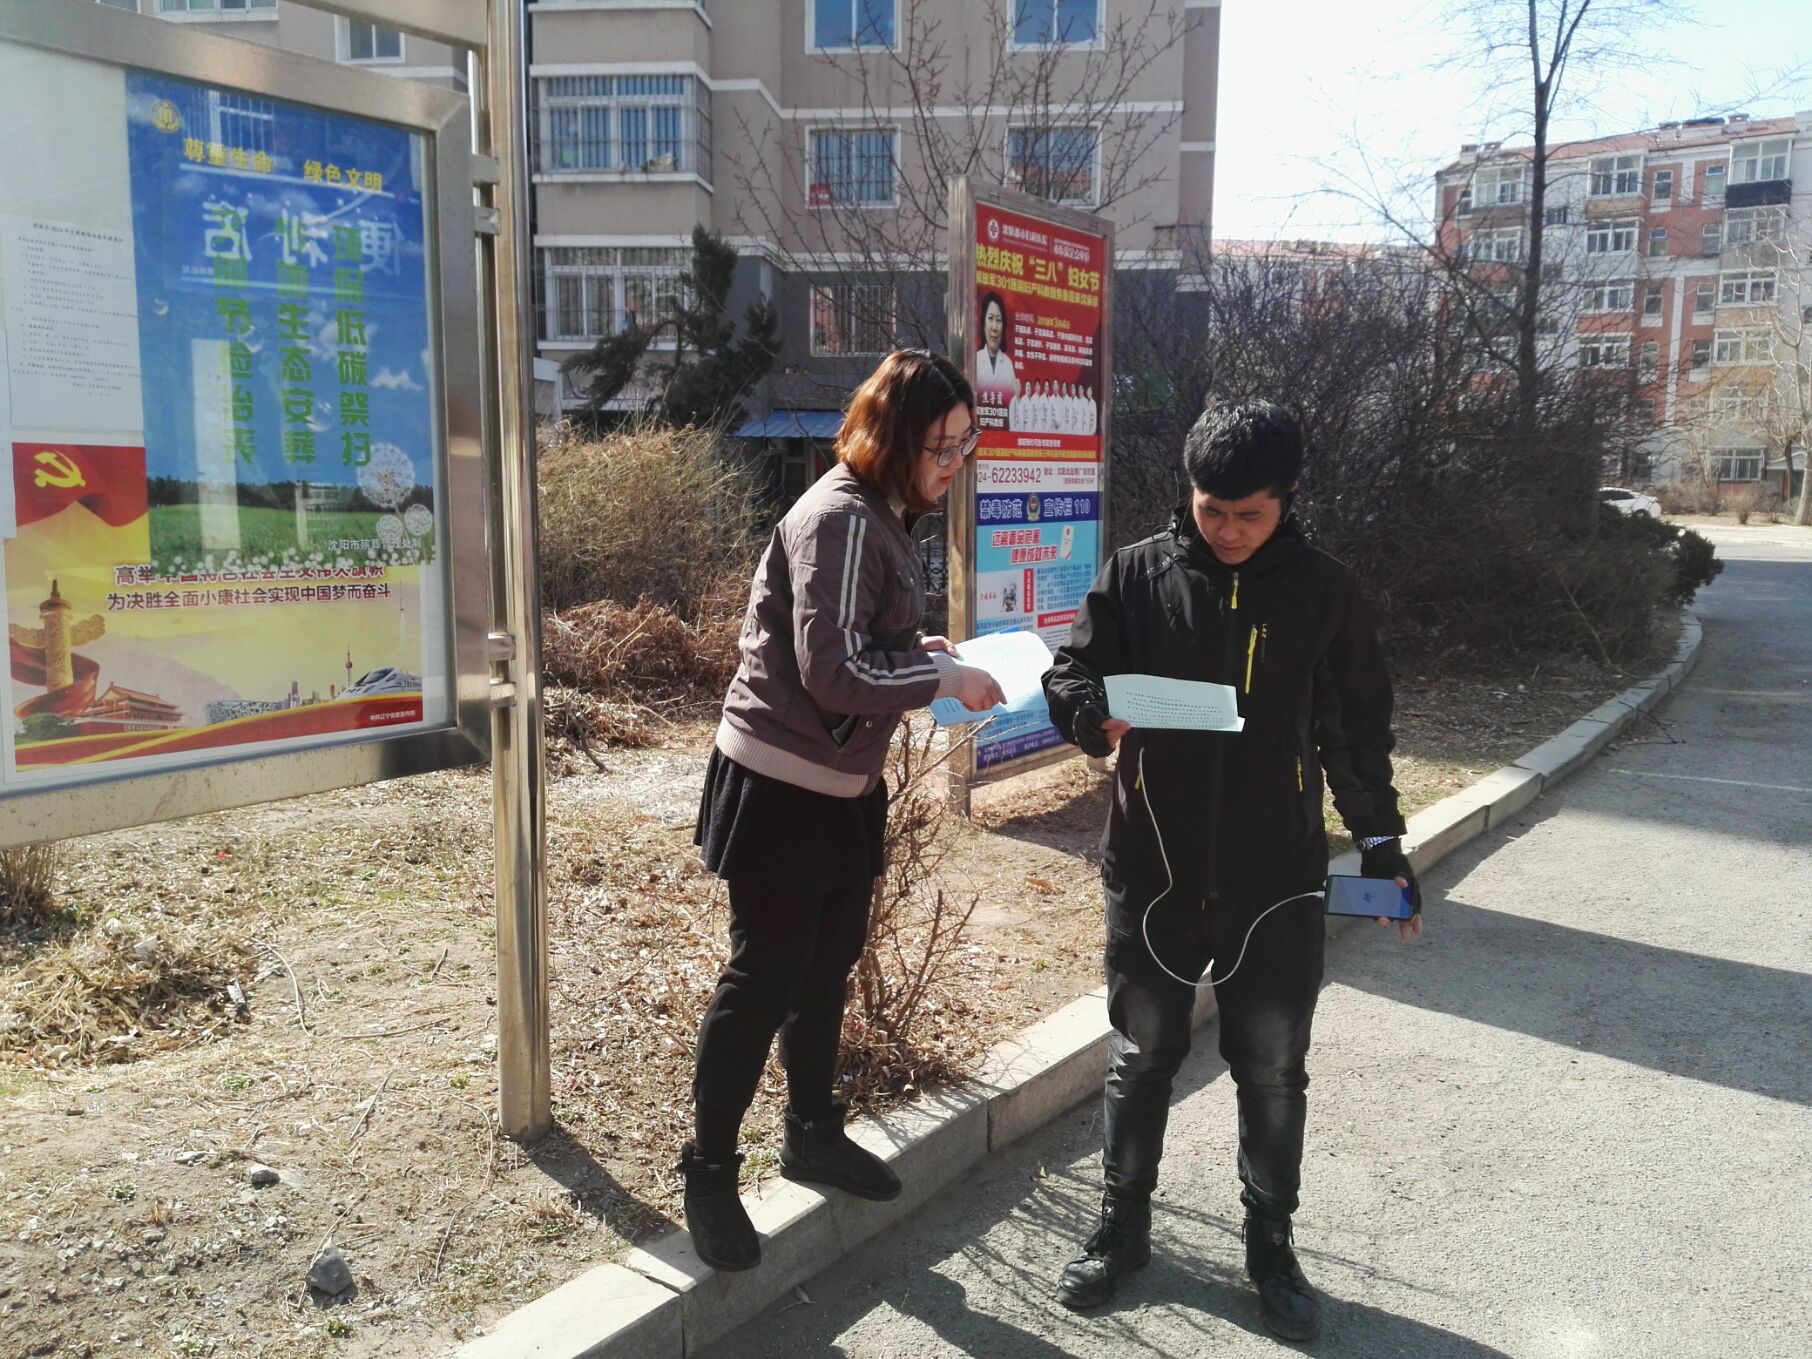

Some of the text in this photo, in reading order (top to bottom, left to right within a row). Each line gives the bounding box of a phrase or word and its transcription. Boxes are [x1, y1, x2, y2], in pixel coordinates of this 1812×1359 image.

[183, 137, 382, 192] 尊重生命 绿色文明
[332, 223, 372, 467] 环保低碳祭扫
[977, 467, 1042, 484] 24-62233942
[979, 497, 1091, 520] 禁毒防范 宣传栏 110
[107, 583, 392, 611] 为决胜全面小康社会实现中国梦而奋斗
